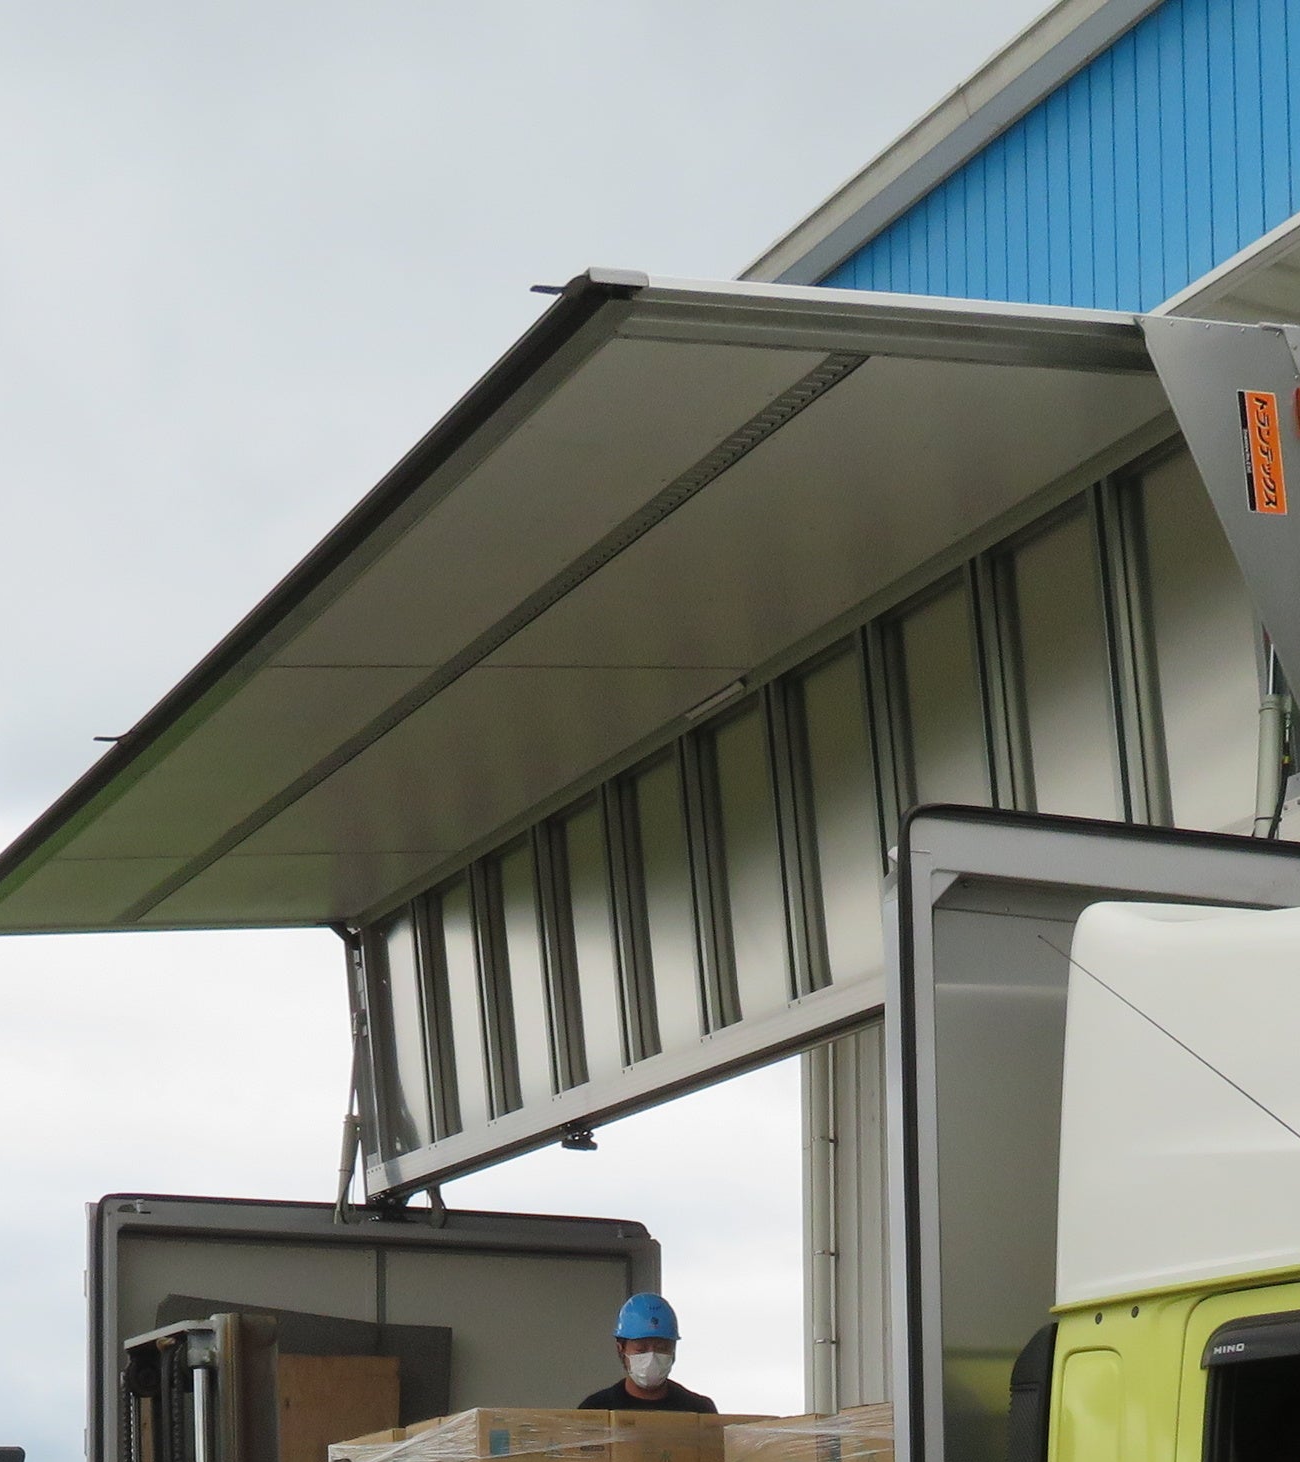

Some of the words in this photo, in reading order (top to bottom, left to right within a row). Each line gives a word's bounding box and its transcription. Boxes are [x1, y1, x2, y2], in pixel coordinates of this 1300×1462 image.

[1254, 397, 1278, 508] トランテックス
[1213, 1343, 1245, 1355] HINO
